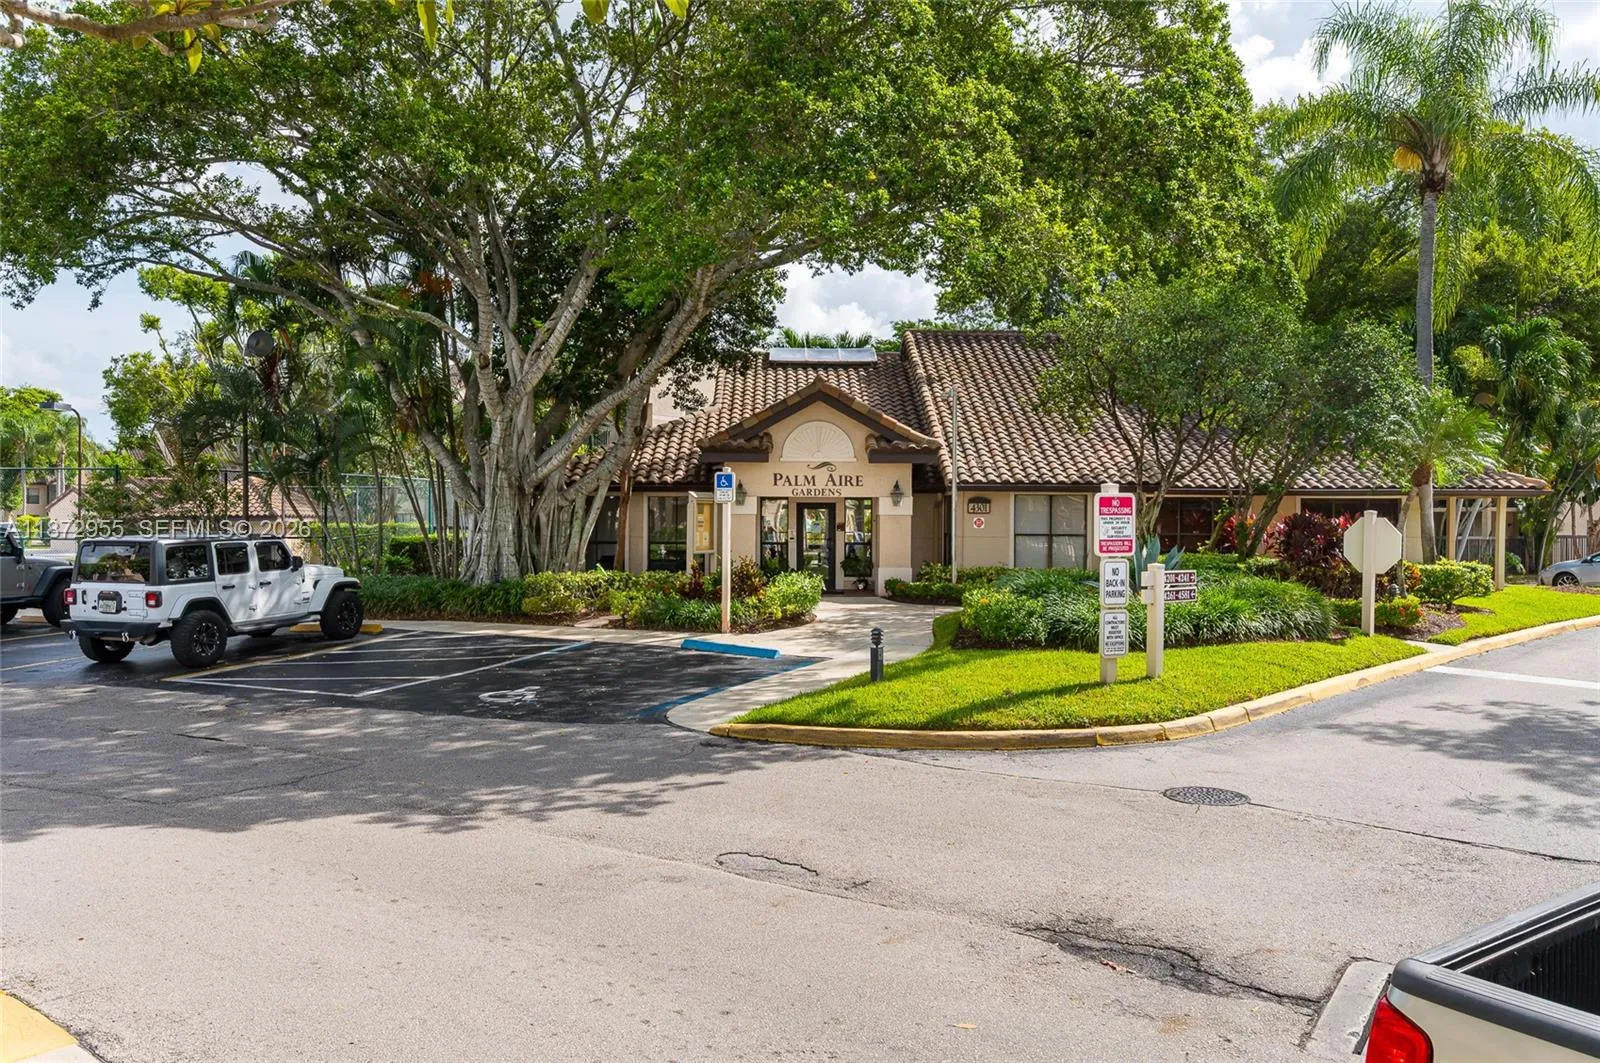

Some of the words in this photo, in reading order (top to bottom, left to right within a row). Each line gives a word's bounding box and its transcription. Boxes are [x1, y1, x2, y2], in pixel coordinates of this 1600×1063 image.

[773, 472, 816, 486] PALM
[825, 473, 864, 486] AIRE
[791, 488, 842, 496] GARDENS
[1111, 499, 1120, 507] NO
[1112, 567, 1120, 576] NO
[1105, 590, 1125, 598] PARKING
